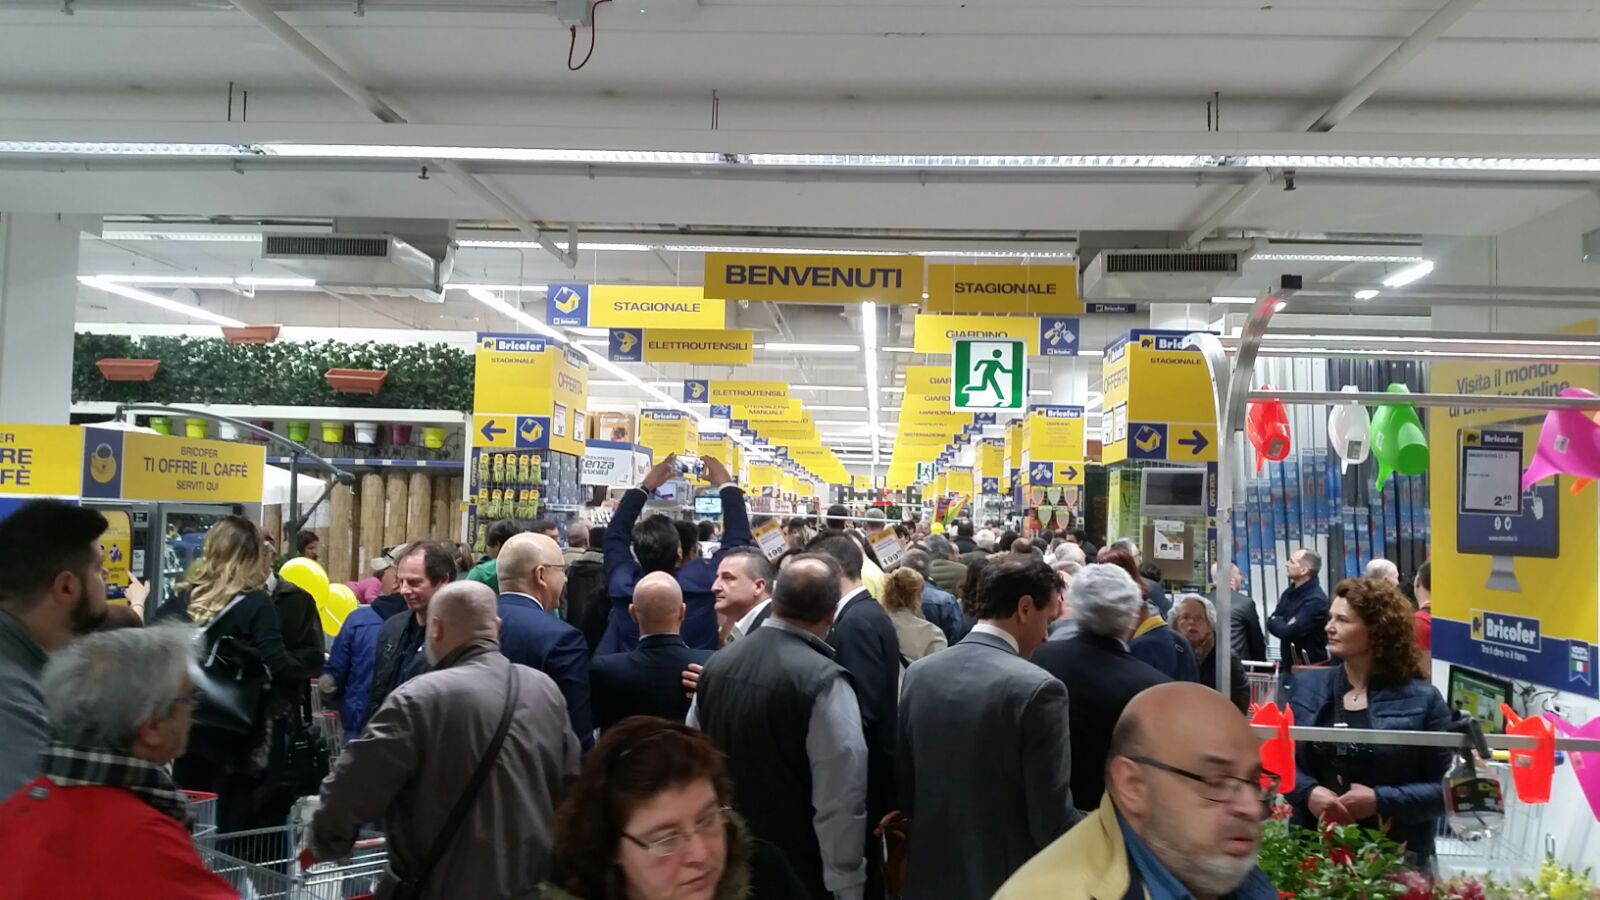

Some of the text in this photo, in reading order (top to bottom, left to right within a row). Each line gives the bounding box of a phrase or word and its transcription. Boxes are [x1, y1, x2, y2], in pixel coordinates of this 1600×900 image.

[725, 264, 902, 289] BENVENUTI
[954, 282, 1056, 295] STAGIONALE
[613, 301, 701, 313] STAGIONALE
[945, 330, 1008, 338] GIARDINO
[498, 340, 542, 351] Bricofer
[648, 341, 748, 351] ELETTROUTENSILI
[1158, 338, 1183, 350] Bric
[1150, 357, 1201, 365] STAGIONALE
[558, 371, 583, 395] OFFERTA
[1103, 366, 1128, 394] OFFERTA
[1457, 363, 1559, 394] Visita il mondo
[712, 389, 786, 397] ELETTROUTENSILI
[1484, 434, 1518, 443] Bricofer
[0, 448, 33, 464] RE
[180, 446, 218, 458] BRICOFER
[143, 456, 248, 478] TI OFFRE IL CAFFÈ
[176, 480, 219, 491] SERVITI QUI
[1486, 618, 1536, 645] Bricofer
